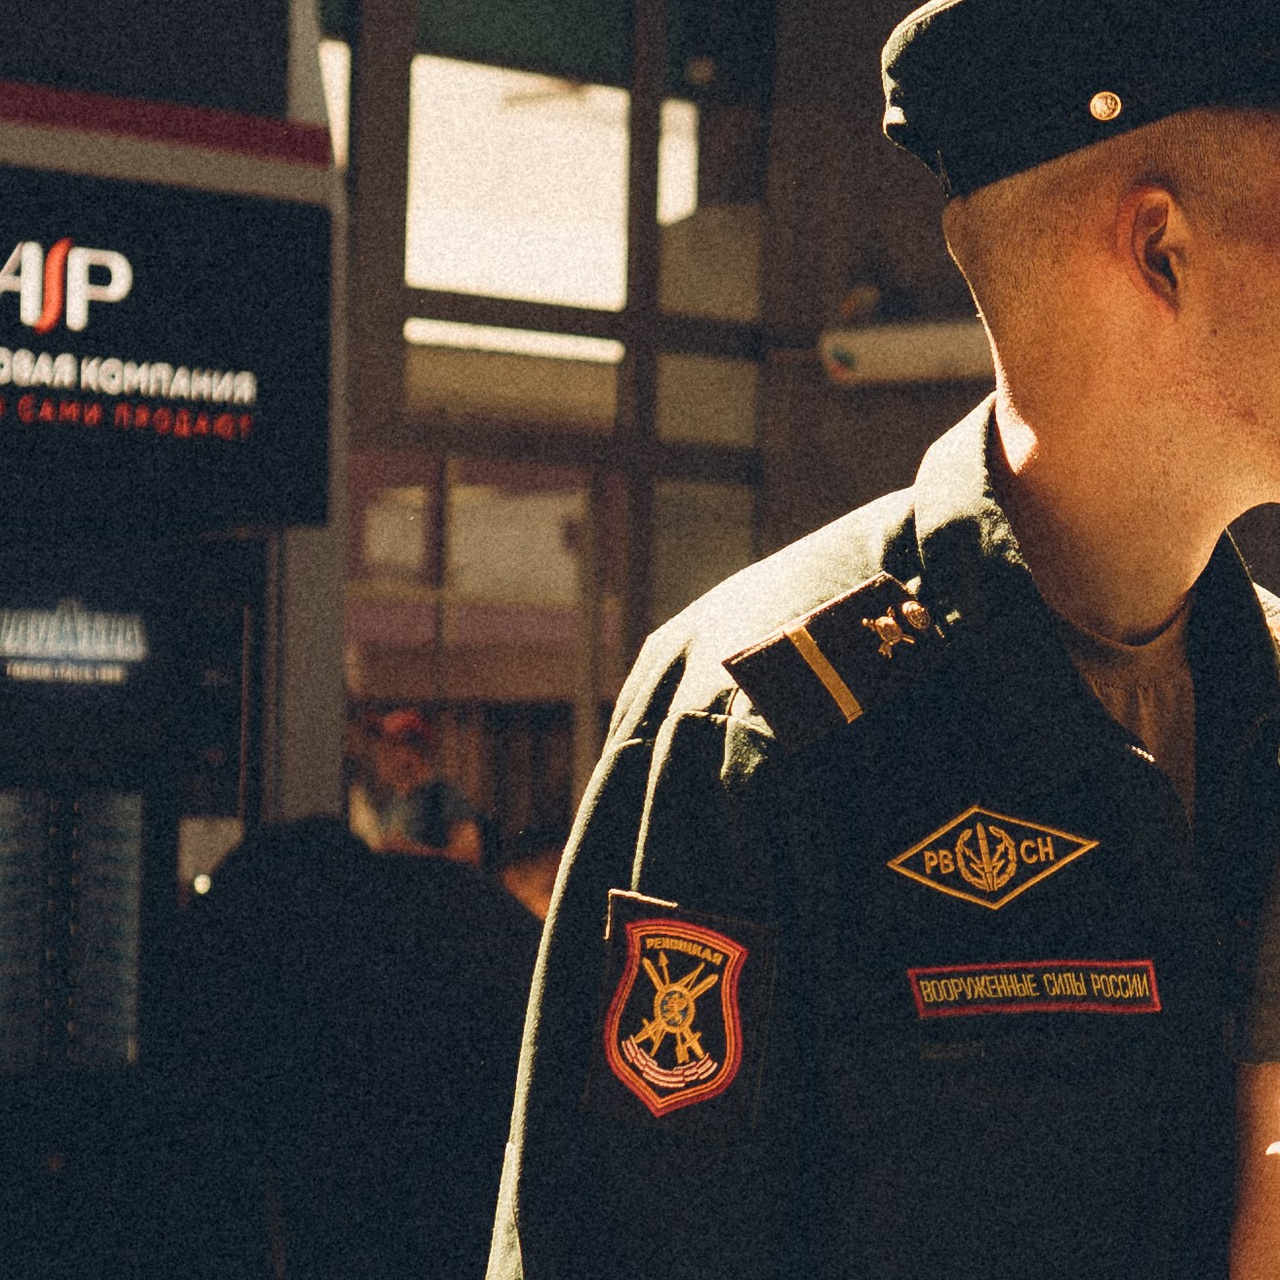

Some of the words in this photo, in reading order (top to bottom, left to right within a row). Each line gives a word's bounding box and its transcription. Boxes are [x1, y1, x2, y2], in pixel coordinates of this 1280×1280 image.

[80, 356, 257, 404] КОМПАНИЯ
[17, 393, 102, 426] САМИ
[113, 402, 252, 439] ПРОДАЮТ
[924, 849, 955, 876] РВ
[1020, 836, 1056, 865] СН
[918, 973, 1040, 1004] ВООРУЖЕННЫЕ
[1043, 971, 1088, 997] СИЛЫ
[1089, 972, 1151, 999] РОССИИ
